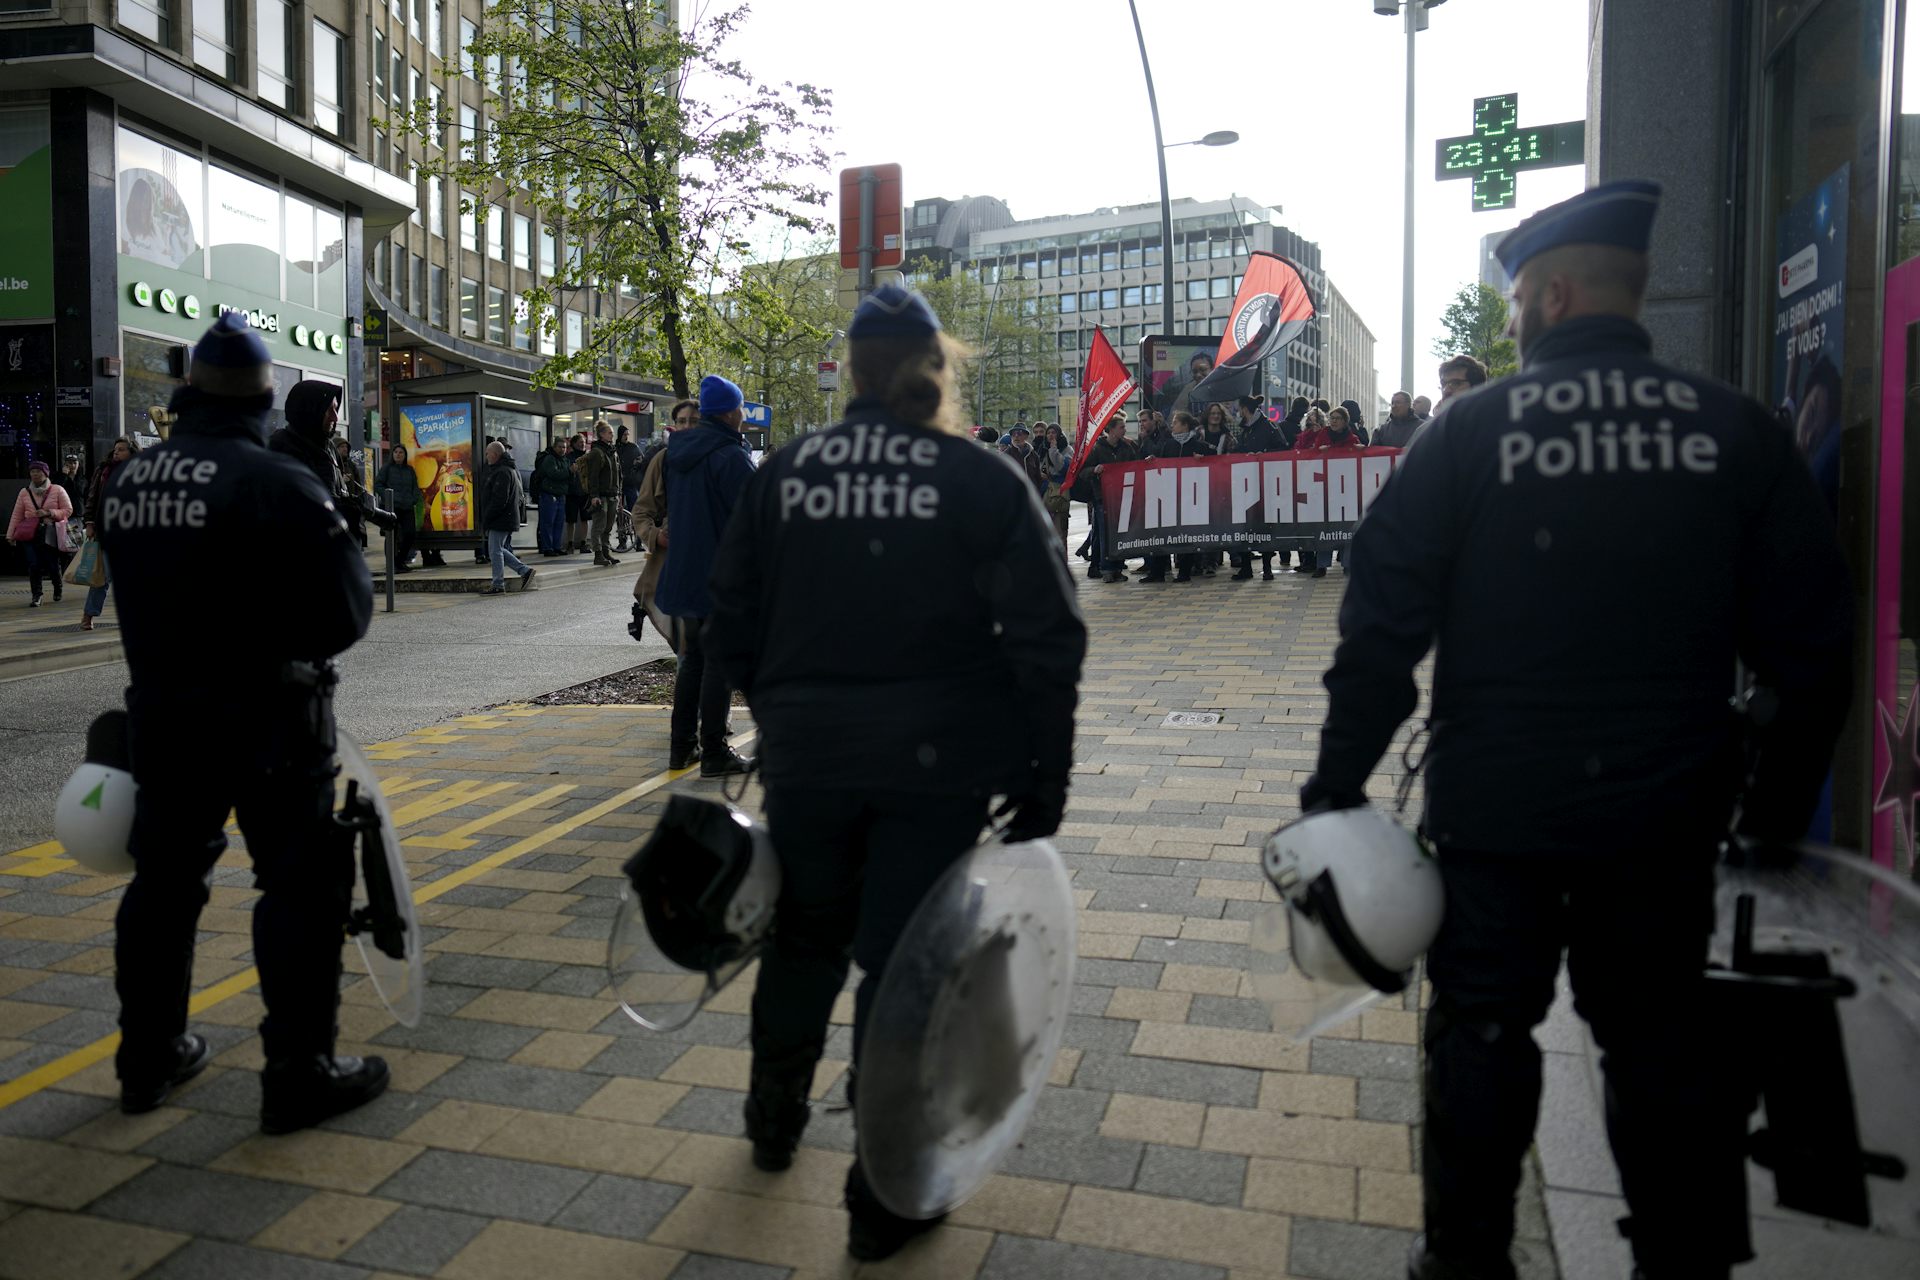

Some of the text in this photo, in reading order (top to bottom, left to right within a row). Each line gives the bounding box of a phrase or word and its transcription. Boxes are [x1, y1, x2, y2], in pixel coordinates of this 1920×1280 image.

[1776, 311, 1789, 335] J'AI
[1790, 299, 1807, 329] BIEN
[1809, 284, 1837, 317] DORMI
[1786, 336, 1797, 361] ET
[1797, 326, 1820, 356] VOUS
[743, 407, 765, 421] M
[1508, 368, 1700, 422] Police
[418, 416, 465, 434] SPARKLING
[792, 424, 941, 469] Police
[116, 449, 218, 488] Police
[1498, 418, 1720, 485] Politie
[103, 487, 208, 532] Politie
[780, 471, 941, 523] Politie
[1231, 456, 1404, 524] PASAR
[1117, 536, 1165, 551] Coordination
[1167, 533, 1220, 545] Antifasciste
[1221, 532, 1233, 542] de
[1234, 532, 1272, 544] Belgique
